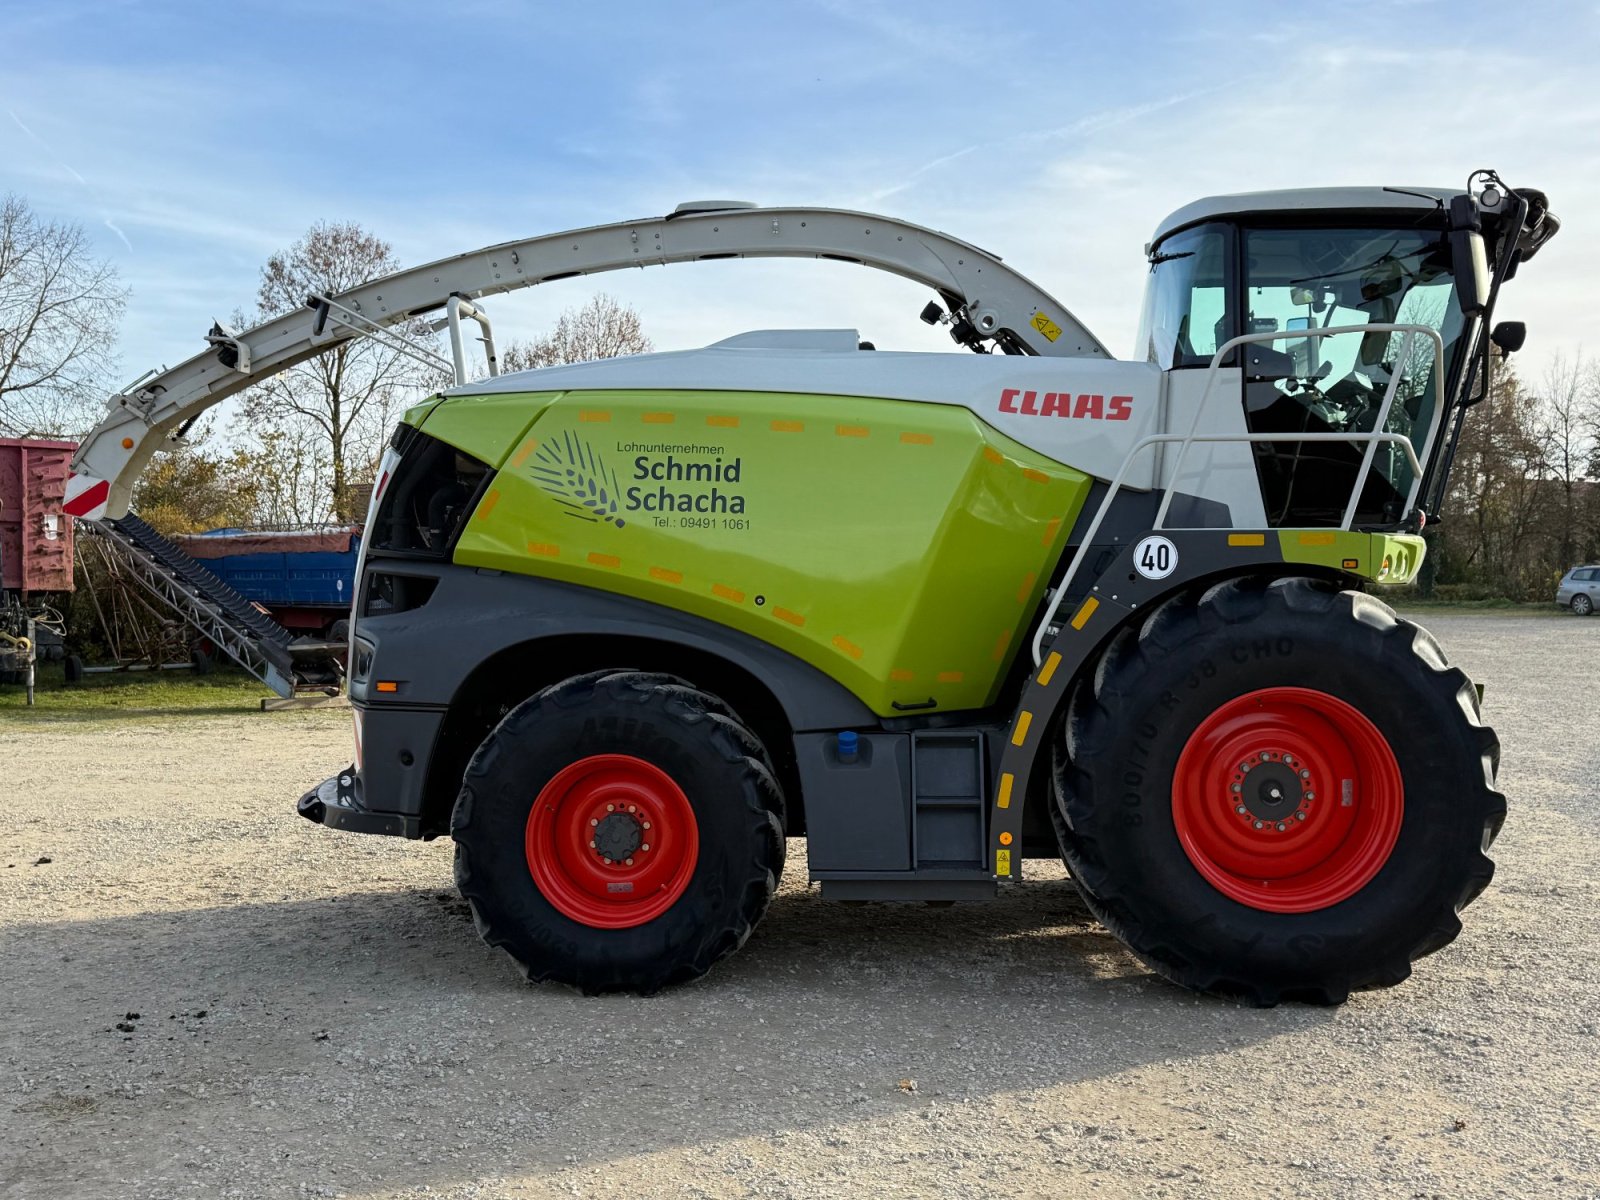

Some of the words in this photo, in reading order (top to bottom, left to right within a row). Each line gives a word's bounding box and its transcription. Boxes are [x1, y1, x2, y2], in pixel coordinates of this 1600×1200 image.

[998, 388, 1134, 421] CLAAS
[617, 441, 725, 455] Lohnunternehmen
[633, 456, 741, 483] Schmid
[625, 486, 745, 514] Schacha
[652, 516, 676, 528] Tel.:
[680, 517, 717, 529] 09491
[721, 519, 751, 530] 1061
[1141, 544, 1170, 571] 40
[1121, 723, 1159, 827] 800/70
